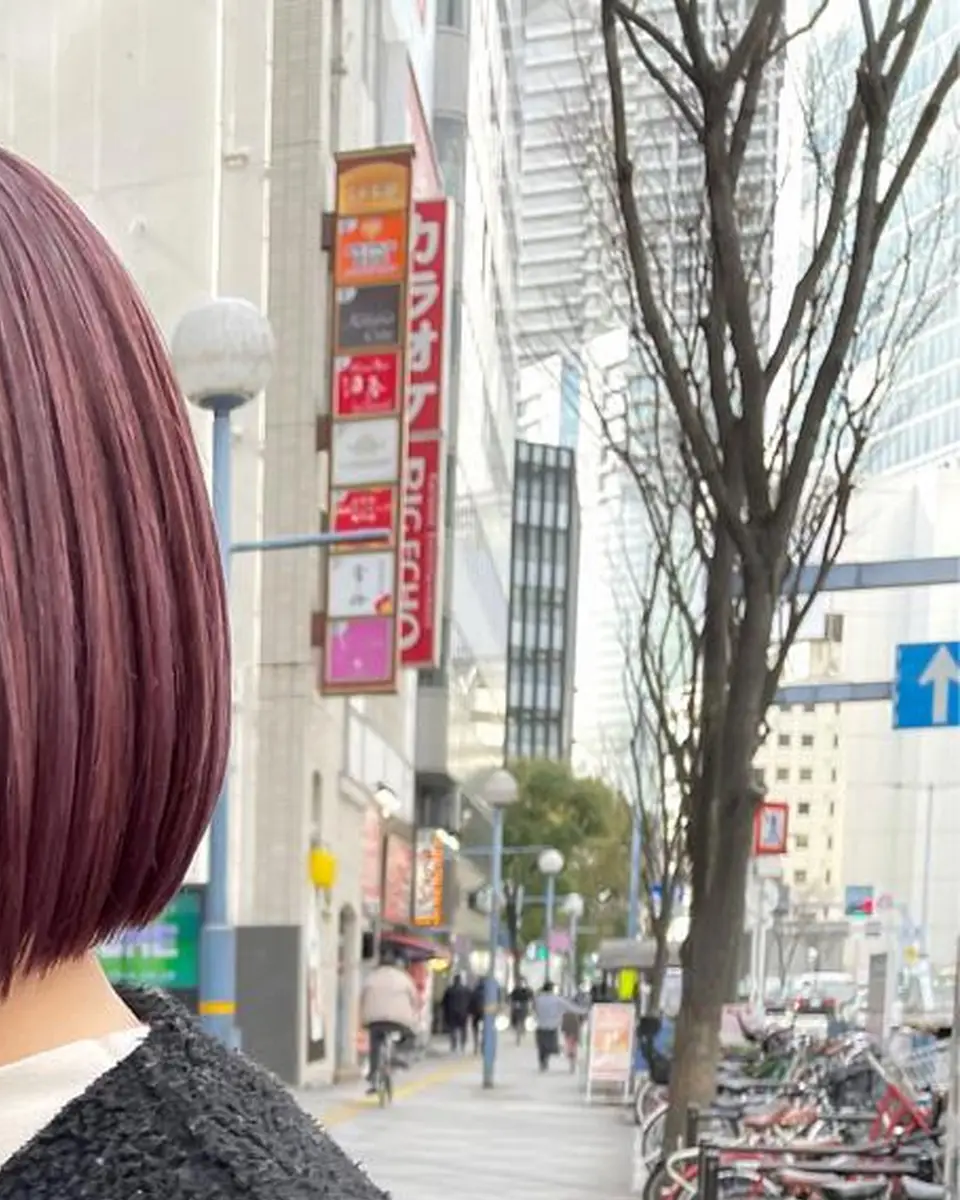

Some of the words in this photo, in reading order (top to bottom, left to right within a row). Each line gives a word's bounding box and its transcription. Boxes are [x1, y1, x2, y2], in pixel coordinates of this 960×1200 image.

[409, 212, 439, 422] カラオケ
[399, 541, 421, 650] ECHO
